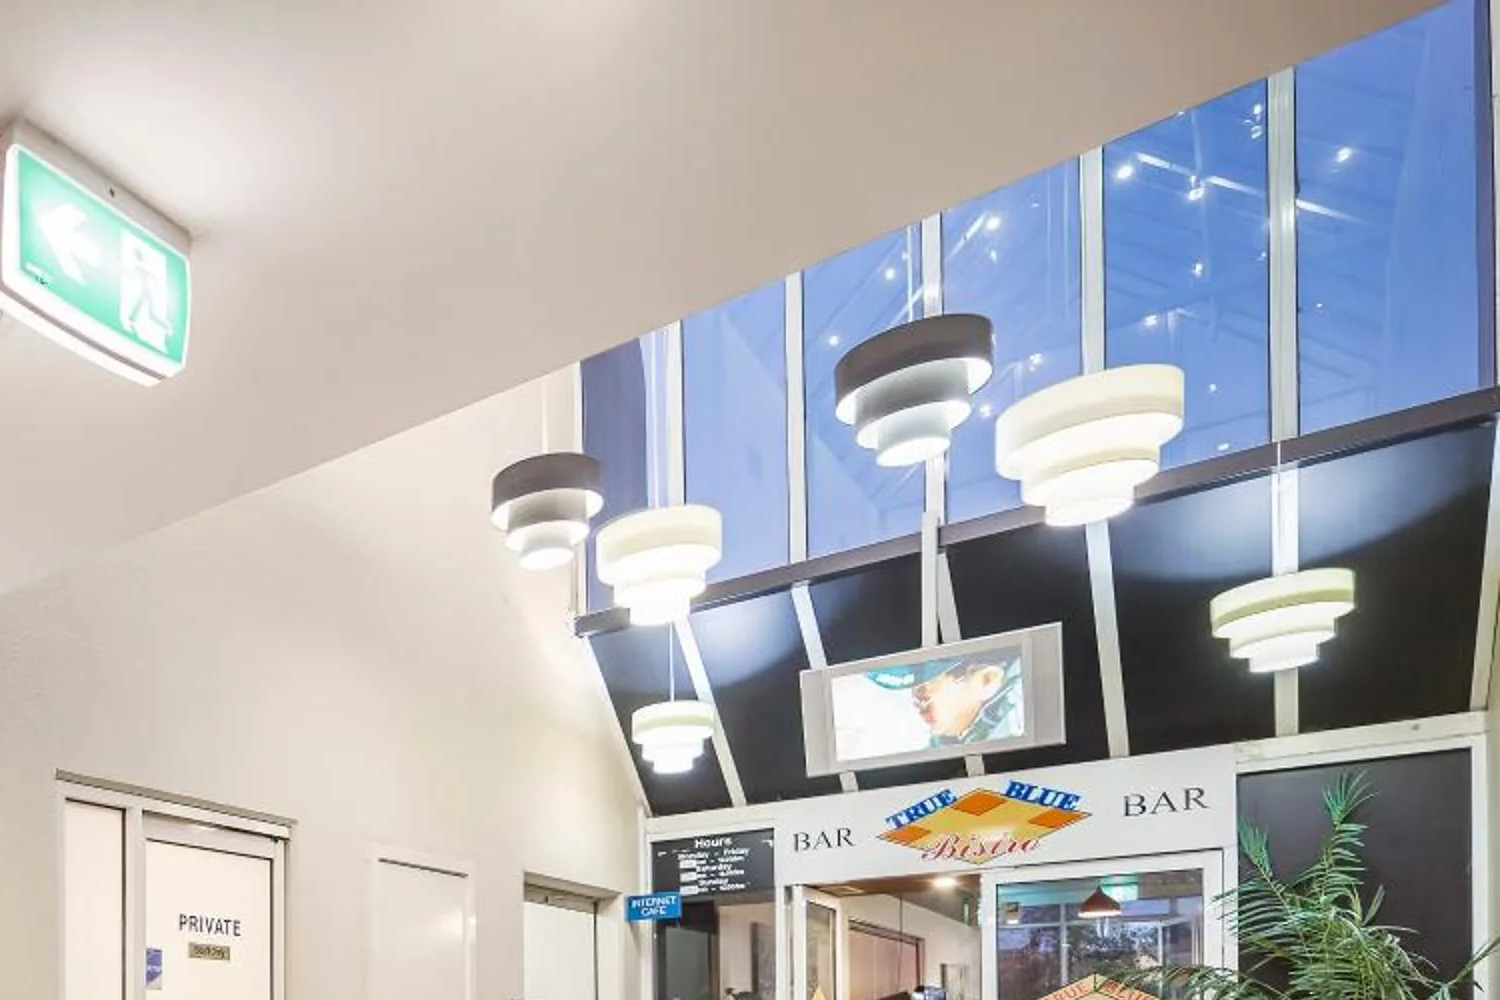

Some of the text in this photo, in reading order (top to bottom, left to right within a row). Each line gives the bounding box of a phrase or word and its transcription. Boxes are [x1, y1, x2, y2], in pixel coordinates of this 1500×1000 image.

[885, 780, 1081, 829] TRUE BLUE
[1123, 787, 1211, 817] BAR
[695, 837, 733, 849] Hours
[793, 827, 855, 853] BAR
[922, 833, 1041, 861] Bistro
[631, 895, 676, 909] INTERNET
[179, 913, 241, 937] PRIVATE
